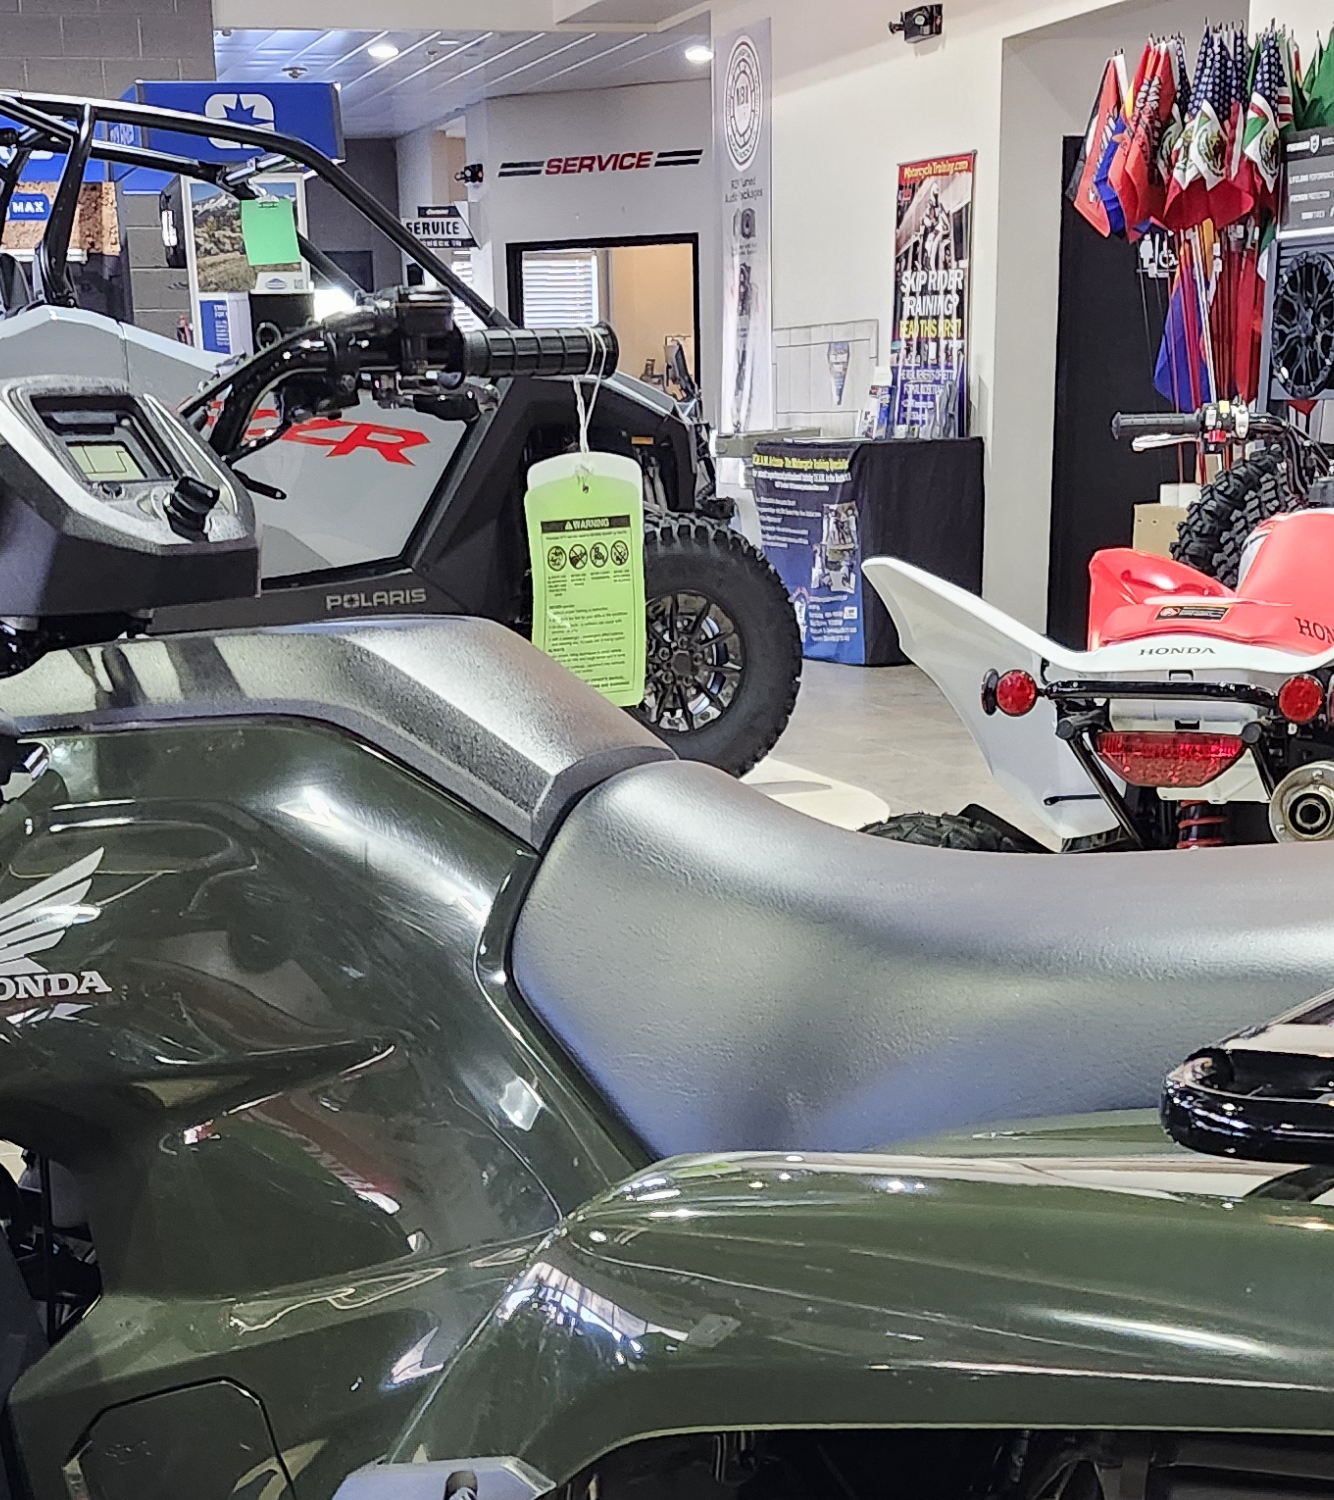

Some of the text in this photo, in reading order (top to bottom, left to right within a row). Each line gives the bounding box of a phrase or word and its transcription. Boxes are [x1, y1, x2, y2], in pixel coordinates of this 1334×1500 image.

[545, 151, 654, 175] SERVICE
[12, 201, 45, 214] MAX
[406, 221, 460, 235] SERVICE
[902, 269, 964, 293] SKIP RIDER
[903, 295, 959, 317] TRAINING?
[918, 320, 938, 338] THIS
[573, 517, 610, 530] WARNING
[326, 588, 426, 610] POLARIS
[1139, 646, 1216, 656] HONDA
